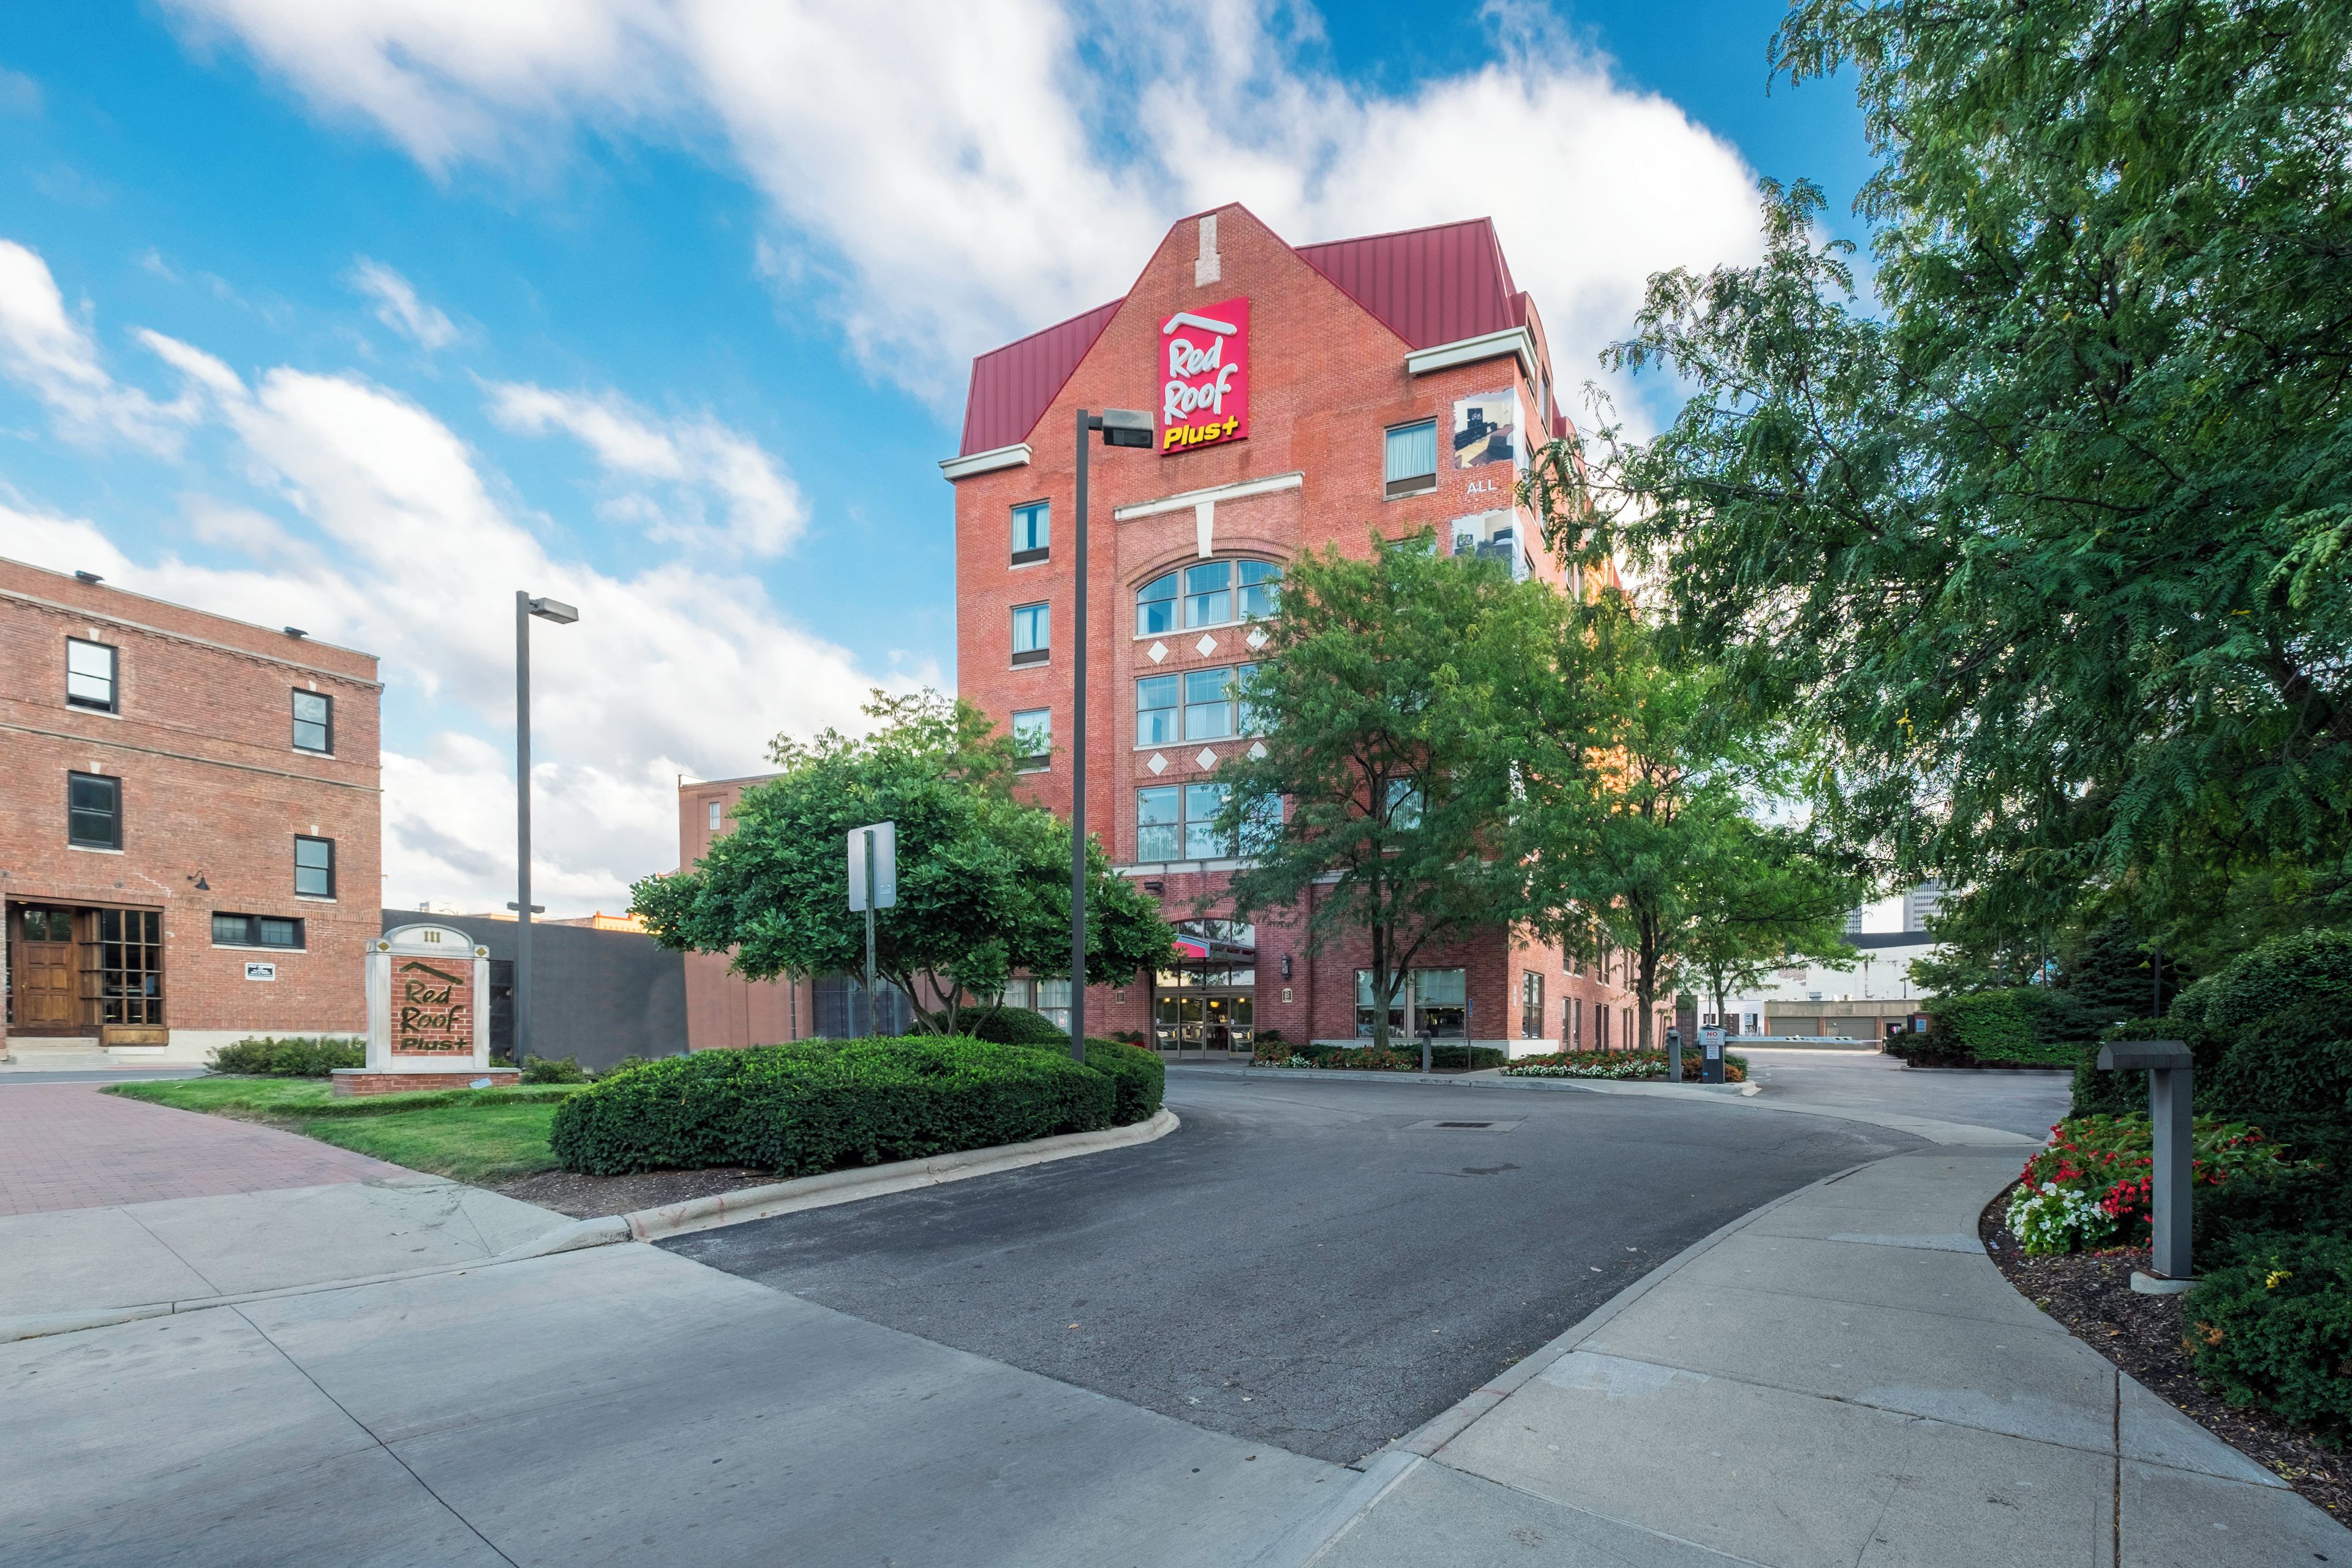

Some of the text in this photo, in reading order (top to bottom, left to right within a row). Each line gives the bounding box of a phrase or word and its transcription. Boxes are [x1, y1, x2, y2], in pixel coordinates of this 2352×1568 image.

[1169, 336, 1224, 378] Red
[1163, 363, 1238, 425] Roof
[1163, 415, 1238, 449] Plus+
[1467, 479, 1497, 494] ALL
[405, 979, 451, 1005] Red
[401, 1005, 464, 1034] Roof
[401, 1038, 467, 1050] Plus+
